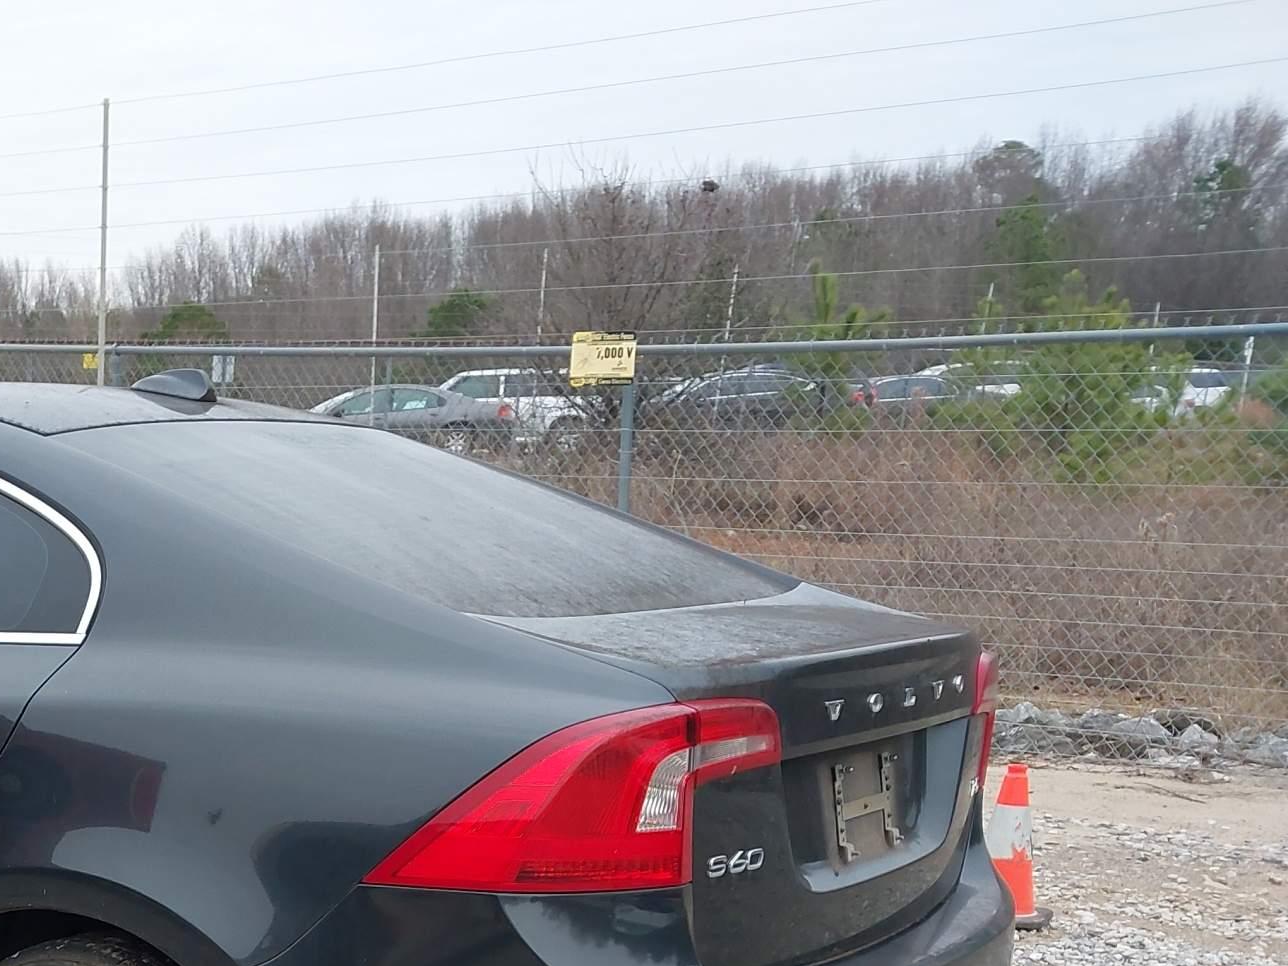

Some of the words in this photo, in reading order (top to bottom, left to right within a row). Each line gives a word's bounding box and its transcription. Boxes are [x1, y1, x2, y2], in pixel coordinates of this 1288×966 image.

[627, 346, 634, 358] V
[824, 675, 965, 721] VOLVO
[707, 847, 765, 878] S60
